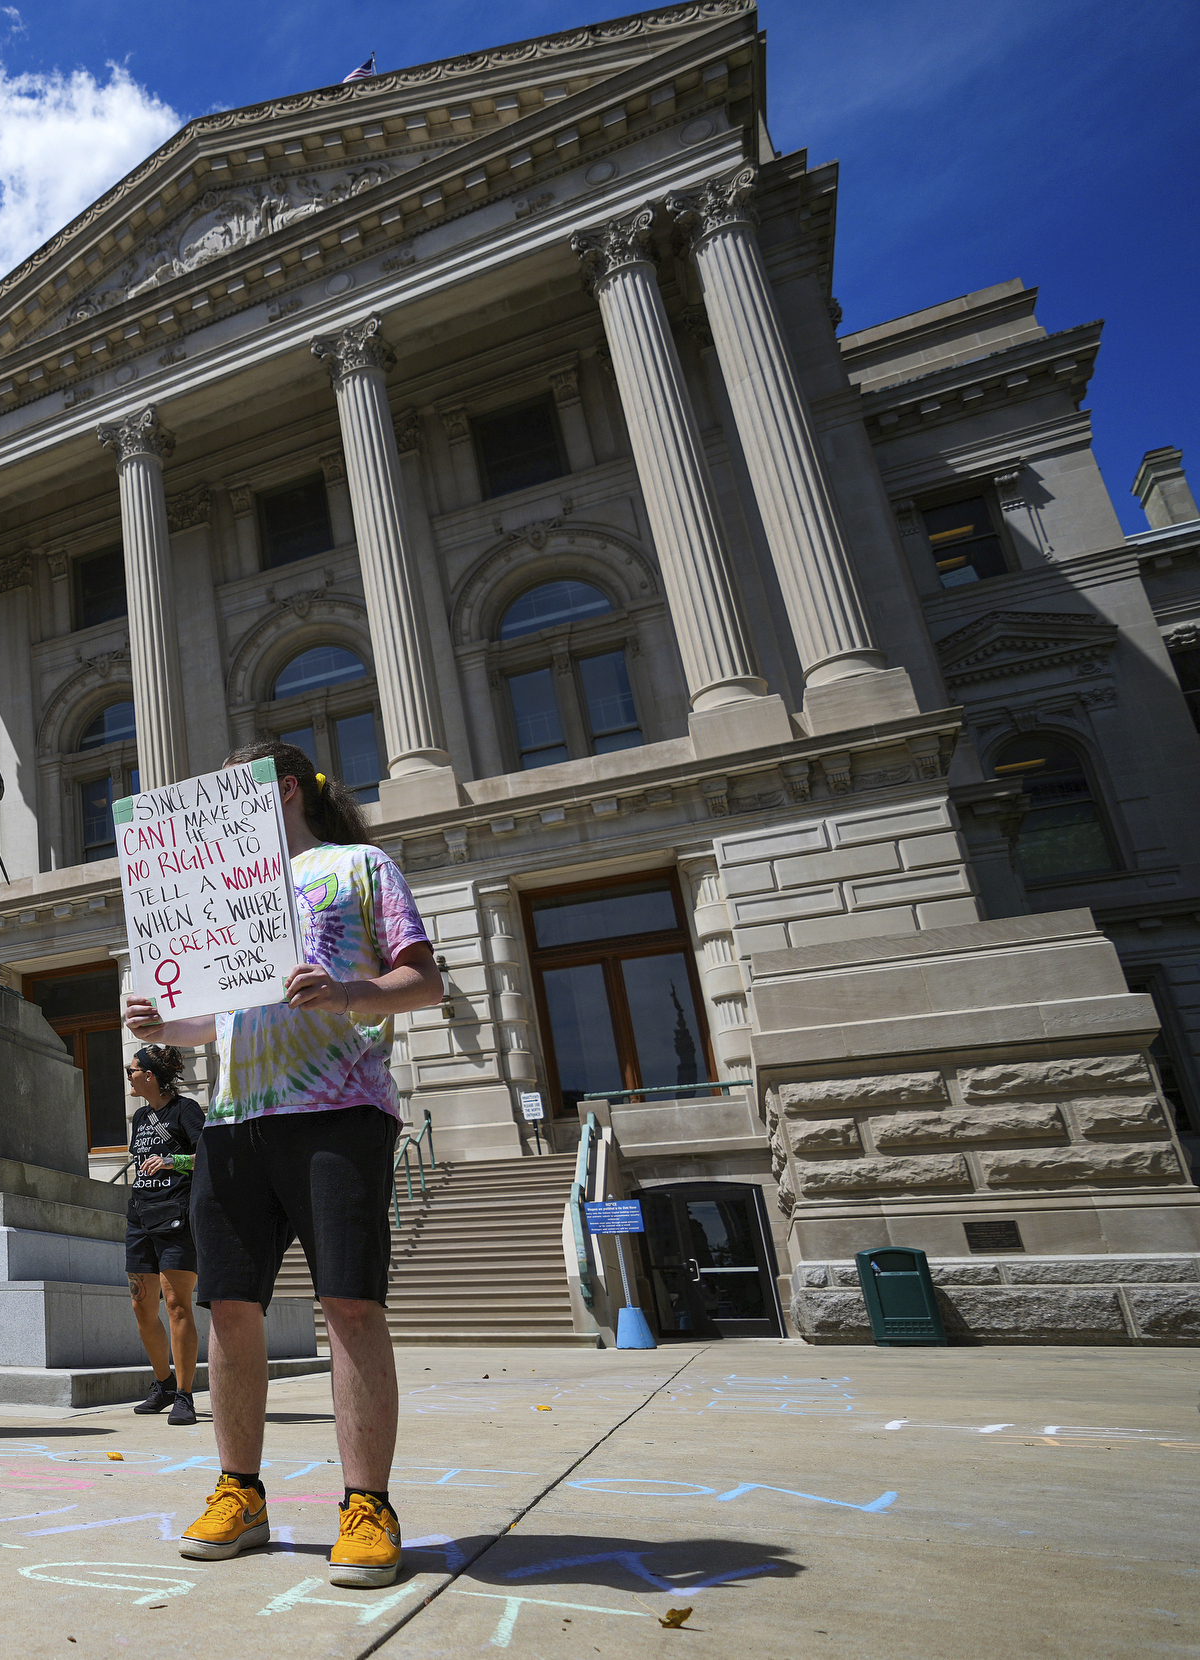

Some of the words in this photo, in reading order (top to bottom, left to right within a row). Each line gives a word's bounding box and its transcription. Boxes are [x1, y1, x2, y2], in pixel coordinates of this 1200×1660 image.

[136, 784, 190, 820] SINCE
[197, 779, 211, 806] A
[216, 764, 261, 801] MAN
[123, 816, 176, 855] CAN'T
[185, 805, 229, 831] MAKE
[241, 791, 273, 815] ONE
[186, 827, 206, 844] HE
[222, 818, 256, 838] HAS
[127, 860, 150, 886] NO
[158, 838, 224, 878] RIGHT
[233, 835, 261, 857] TO
[131, 884, 189, 907] TELL
[200, 876, 216, 893] A
[221, 852, 281, 891] WOMAN
[133, 904, 192, 938] WHEN
[203, 898, 218, 923] &
[226, 888, 283, 923] WHERE
[134, 941, 161, 964] TO
[169, 924, 240, 957] CREATE
[249, 916, 288, 944] ONE!
[214, 946, 267, 976] TUPAC
[218, 964, 276, 990] SHAKUR
